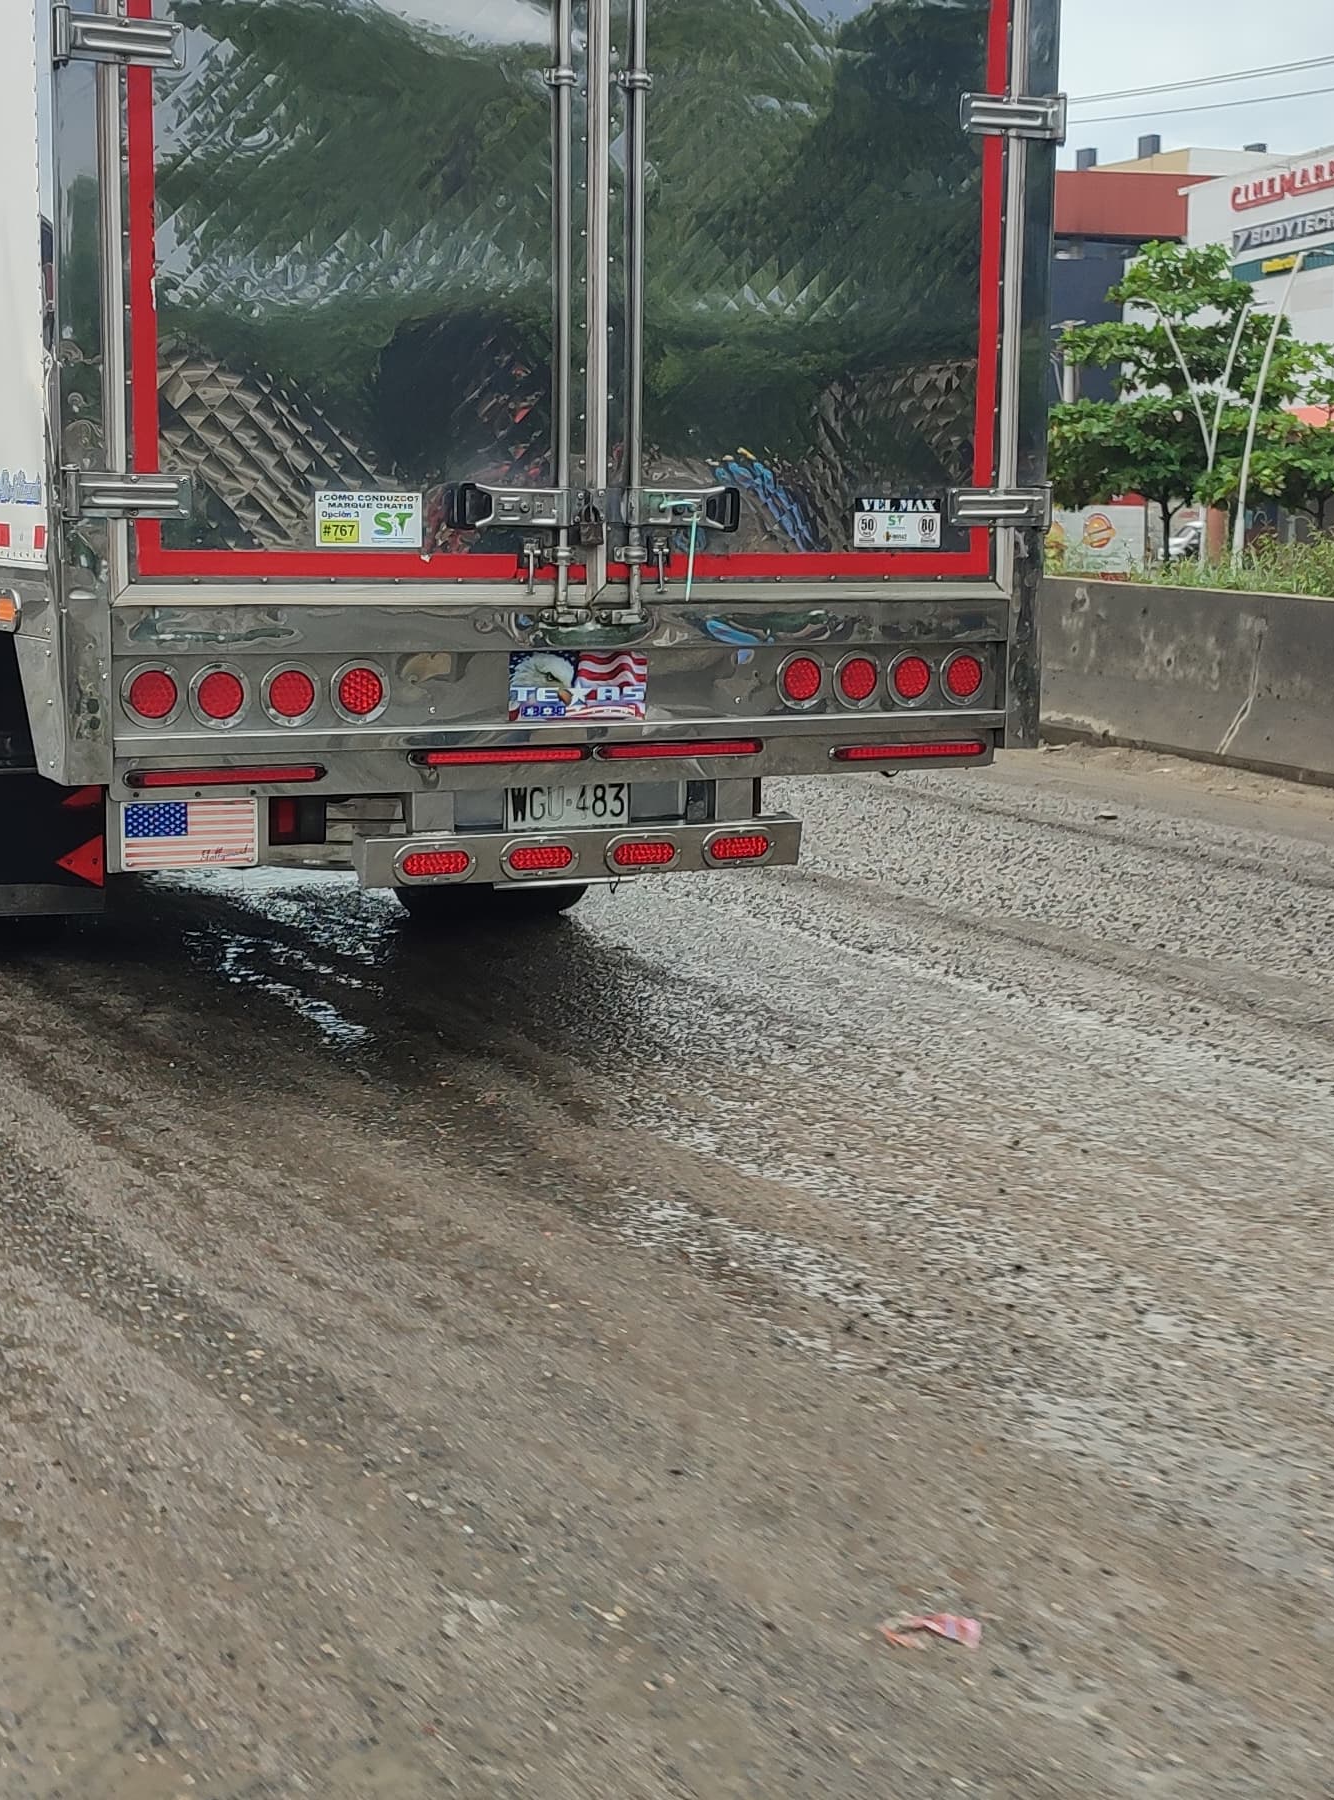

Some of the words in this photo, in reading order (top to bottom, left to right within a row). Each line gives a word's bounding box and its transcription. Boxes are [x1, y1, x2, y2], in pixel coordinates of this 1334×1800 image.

[357, 494, 419, 503] CONDUZCO?
[861, 499, 896, 512] VEL
[898, 499, 936, 512] MAX
[323, 524, 355, 536] #767
[860, 518, 874, 531] 50
